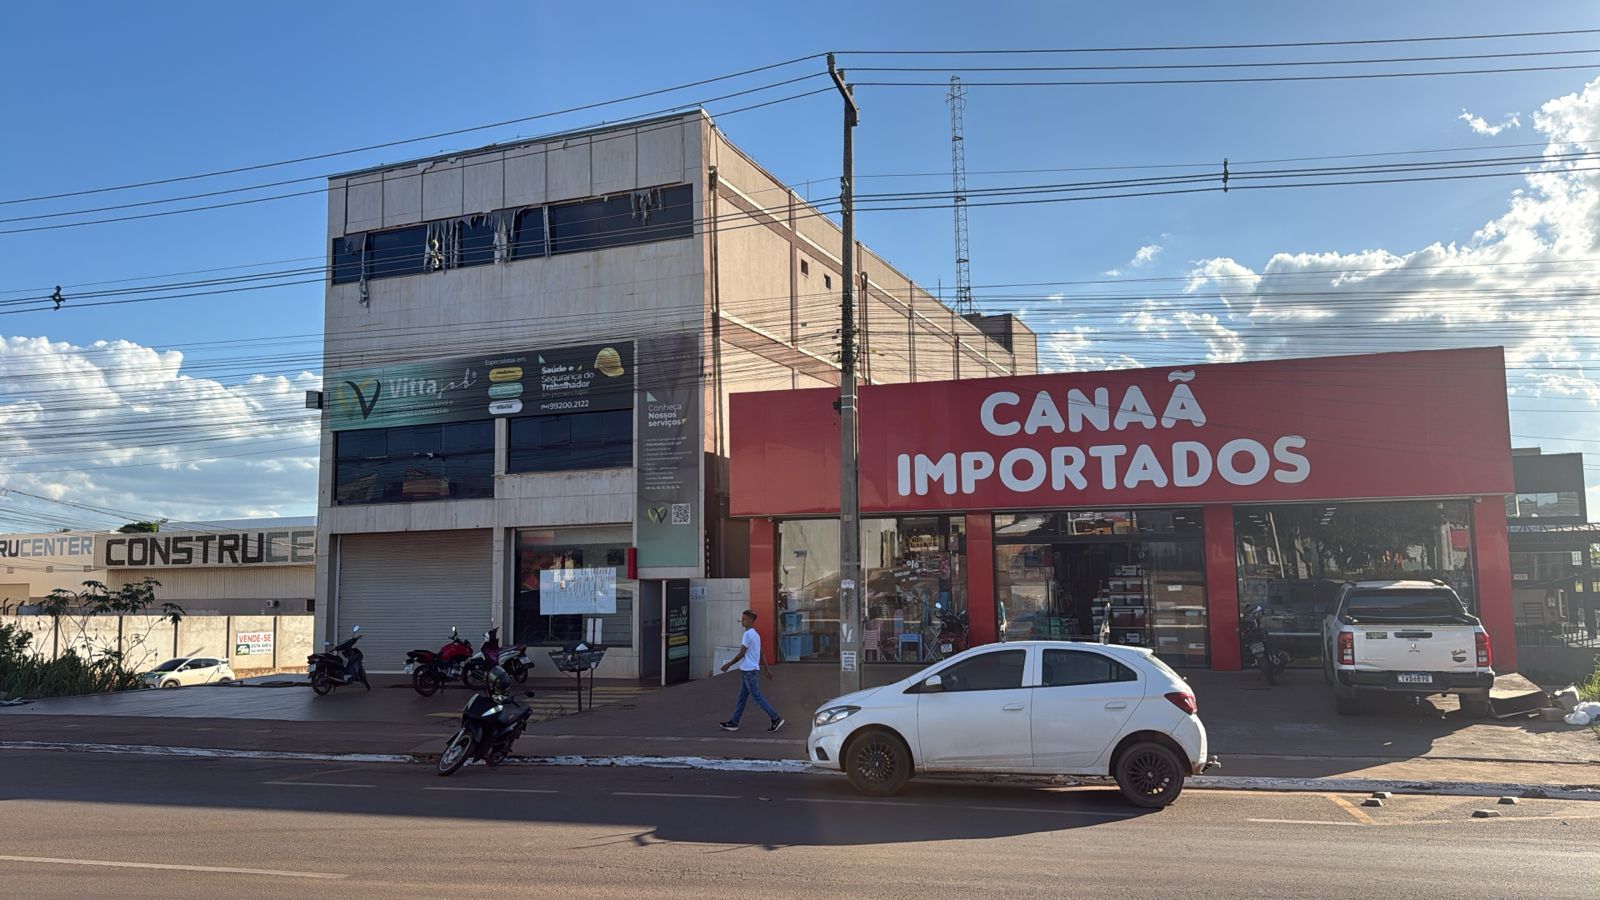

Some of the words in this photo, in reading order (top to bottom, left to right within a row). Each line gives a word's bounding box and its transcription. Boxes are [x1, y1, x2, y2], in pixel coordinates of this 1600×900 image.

[541, 365, 567, 375] Saúde
[541, 372, 582, 384] Segurança
[583, 371, 595, 380] do
[388, 376, 436, 399] Vitta
[541, 380, 590, 391] Trabalhador
[648, 403, 682, 414] Conheça
[980, 369, 1207, 437] CANAÃ
[648, 411, 677, 420] Nossos
[648, 418, 682, 428] serviços
[896, 434, 1311, 497] IMPORTADOS
[105, 530, 315, 566] CONSTRUCE
[238, 633, 272, 643] VENDE-SE
